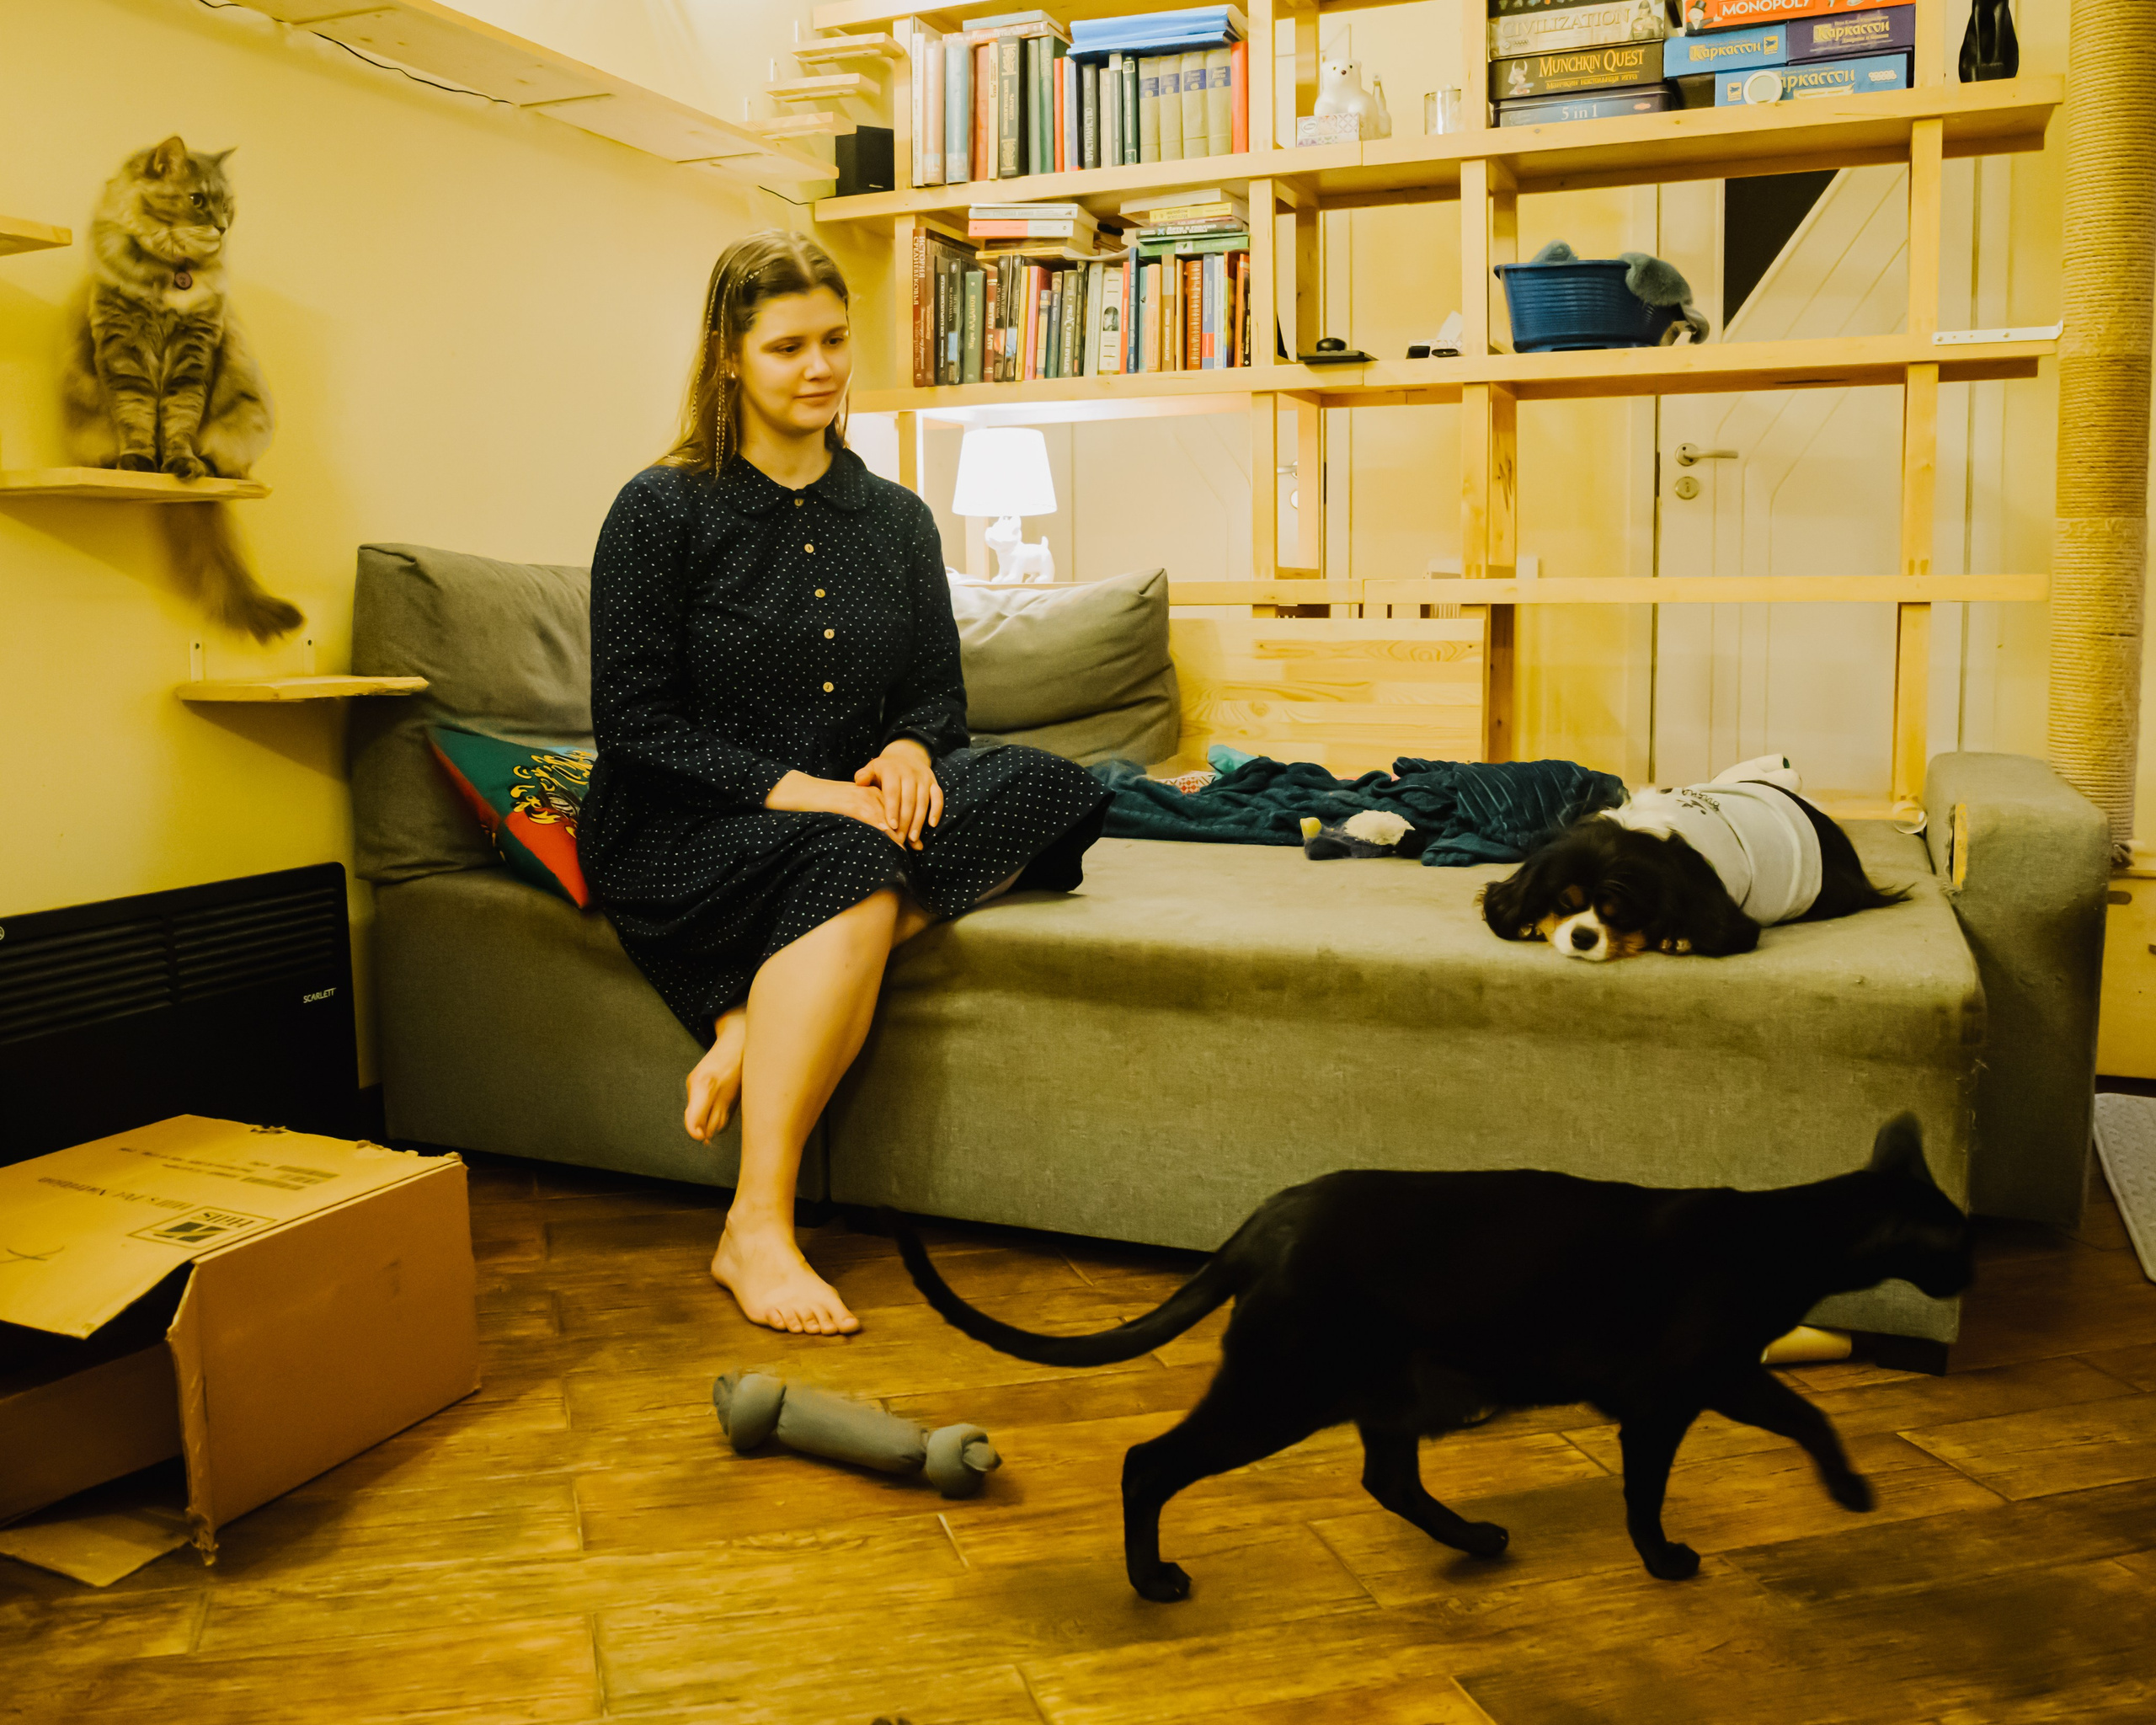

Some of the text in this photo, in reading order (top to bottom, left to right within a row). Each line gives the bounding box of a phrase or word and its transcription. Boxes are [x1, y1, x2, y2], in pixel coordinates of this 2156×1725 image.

[1502, 8, 1630, 38] CIVILIZATION
[1539, 49, 1645, 77] MUNCHKIN QUEST
[1689, 42, 1761, 62] Каркассон
[1561, 104, 1598, 120] 5 in 1
[1084, 107, 1094, 163] ХРИСТИАНСТВО
[303, 987, 337, 1003] SCARLETT
